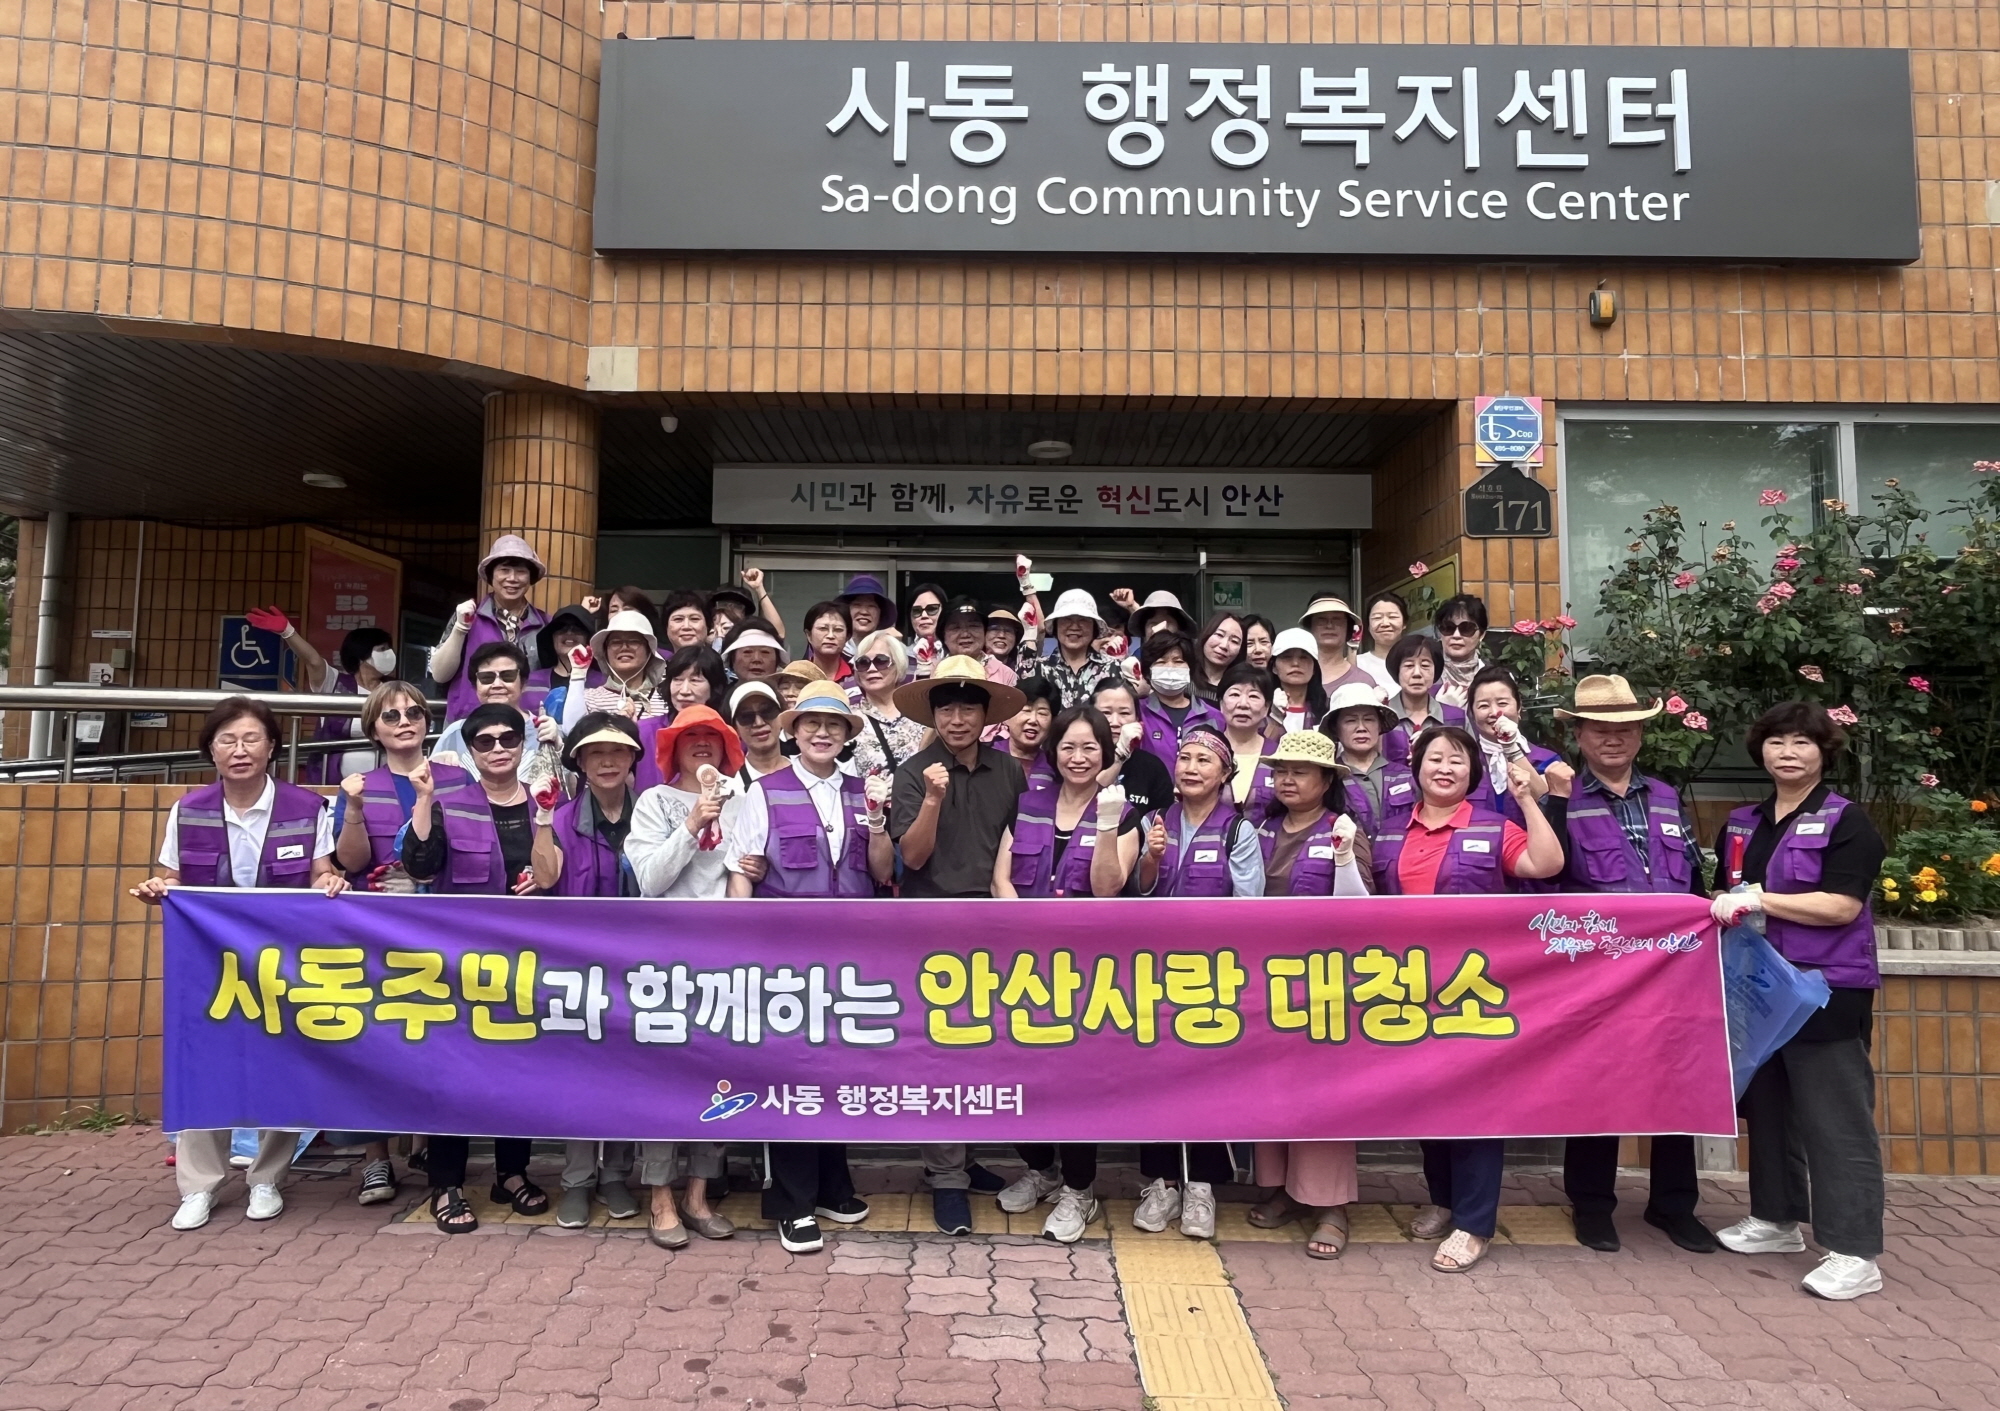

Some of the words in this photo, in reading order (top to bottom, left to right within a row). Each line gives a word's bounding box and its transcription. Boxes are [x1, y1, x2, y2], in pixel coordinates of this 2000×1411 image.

[825, 60, 1029, 166] 사동
[1082, 61, 1692, 173] 행정복지센터
[821, 173, 1018, 225] Sa-dong
[1036, 176, 1321, 228] Community
[1338, 179, 1508, 220] Service
[1526, 181, 1690, 221] Center
[790, 481, 878, 513] 시민과
[890, 482, 956, 514] 함께,
[966, 483, 1084, 515] 자유로운
[1096, 484, 1210, 516] 혁신도시
[1221, 484, 1285, 517] 안산
[1492, 500, 1547, 531] 171
[1528, 908, 1581, 942] 시민과
[1656, 931, 1703, 955] 안산
[208, 946, 609, 1042] 사동주민과
[625, 963, 901, 1045] 함께하는
[918, 948, 1246, 1046] 안산사랑
[1264, 947, 1517, 1044] 대청소
[761, 1083, 825, 1116] 사동
[836, 1084, 1024, 1117] 행정복지센터
